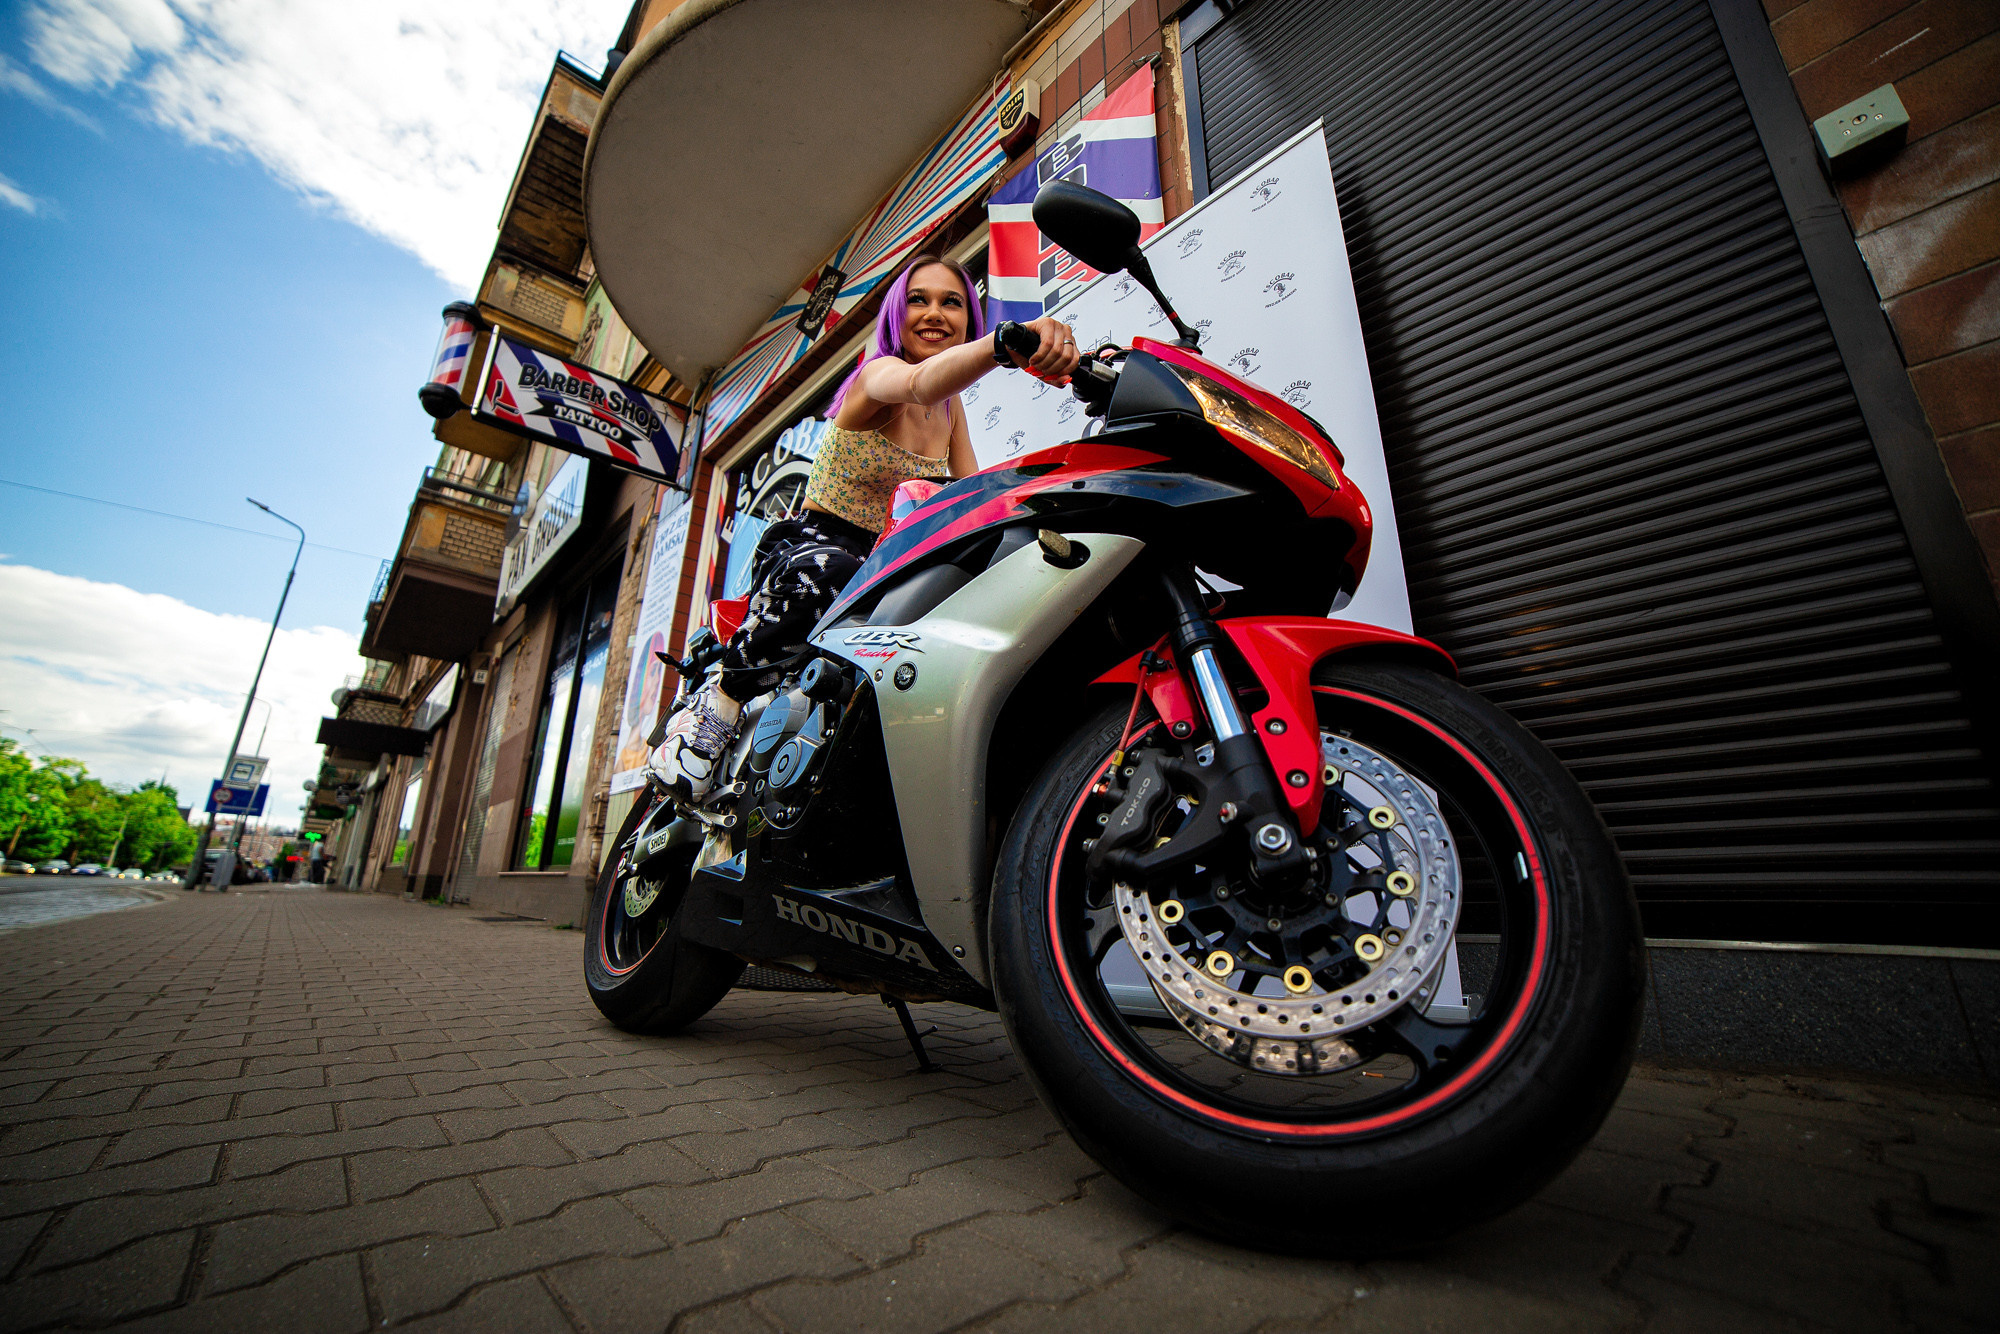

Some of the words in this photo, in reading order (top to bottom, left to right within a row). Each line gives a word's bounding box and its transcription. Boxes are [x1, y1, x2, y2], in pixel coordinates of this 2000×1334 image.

[1002, 92, 1023, 118] SOLID
[1250, 177, 1280, 198] ESCOBAR
[1177, 229, 1203, 247] ESCOBAR
[1217, 250, 1246, 269] ESCOBAR
[1263, 272, 1295, 292] ESCOBAR
[1228, 347, 1260, 366] ESCOBAR
[518, 362, 606, 408] BARBER
[607, 390, 661, 441] SHOP
[554, 404, 623, 440] TATTOO
[653, 529, 686, 565] DAMSKI
[843, 631, 926, 655] CBR
[854, 647, 898, 664] Racing
[760, 719, 782, 729] HONDA
[1121, 777, 1151, 827] TOKICO
[650, 832, 667, 850] SHOEI
[772, 894, 939, 973] HONDA
